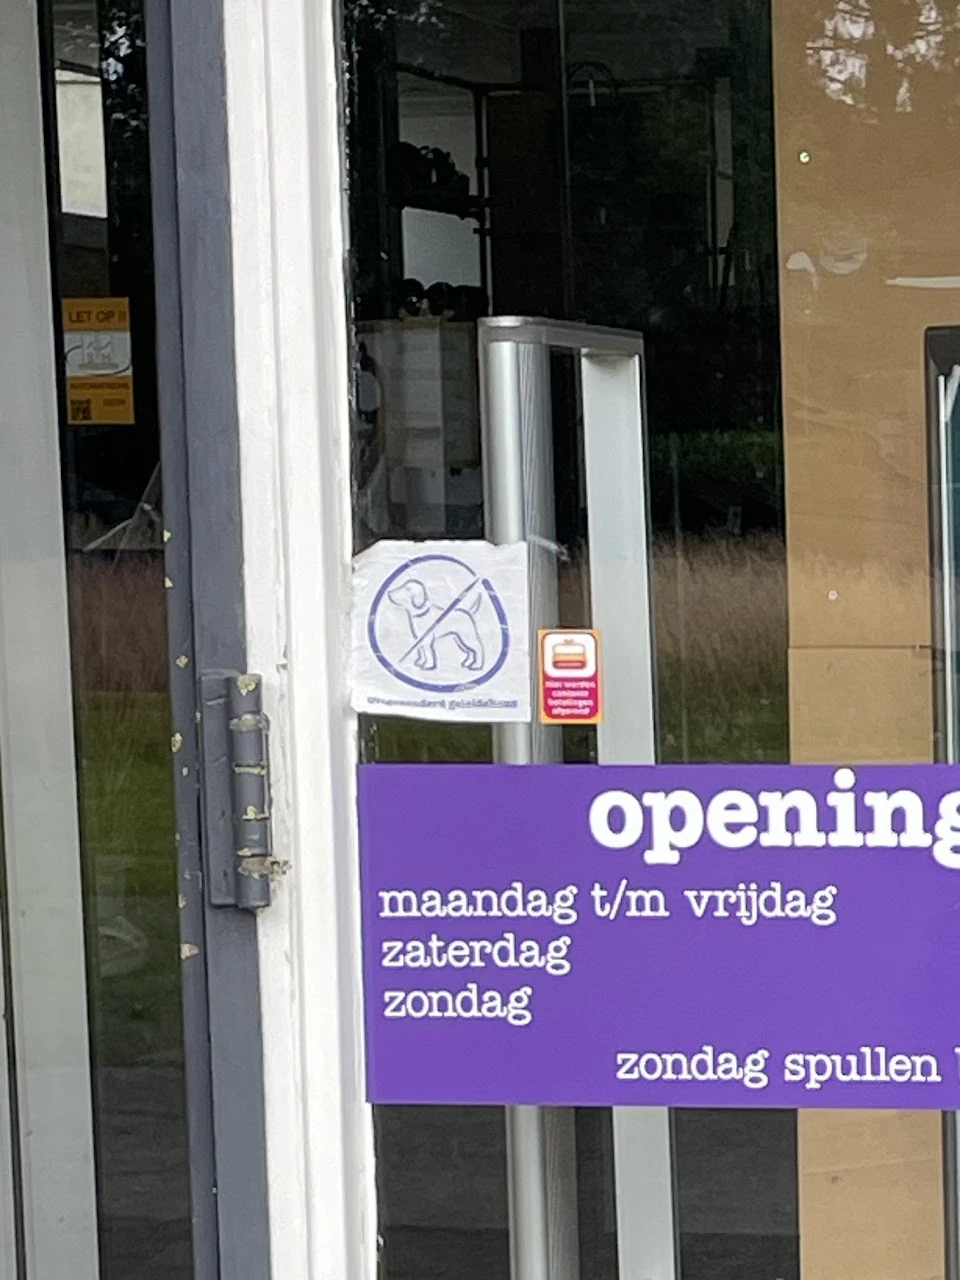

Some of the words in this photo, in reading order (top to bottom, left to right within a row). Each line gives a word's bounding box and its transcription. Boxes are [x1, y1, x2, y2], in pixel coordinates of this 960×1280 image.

[68, 311, 92, 323] LET
[96, 311, 115, 323] OP
[378, 882, 578, 925] maandag
[590, 879, 671, 920] t/m
[683, 881, 838, 926] vrijdag
[381, 932, 572, 976] zaterdag
[383, 982, 533, 1026] zondag
[616, 1044, 770, 1089] zondag
[784, 1046, 942, 1090] spullen
